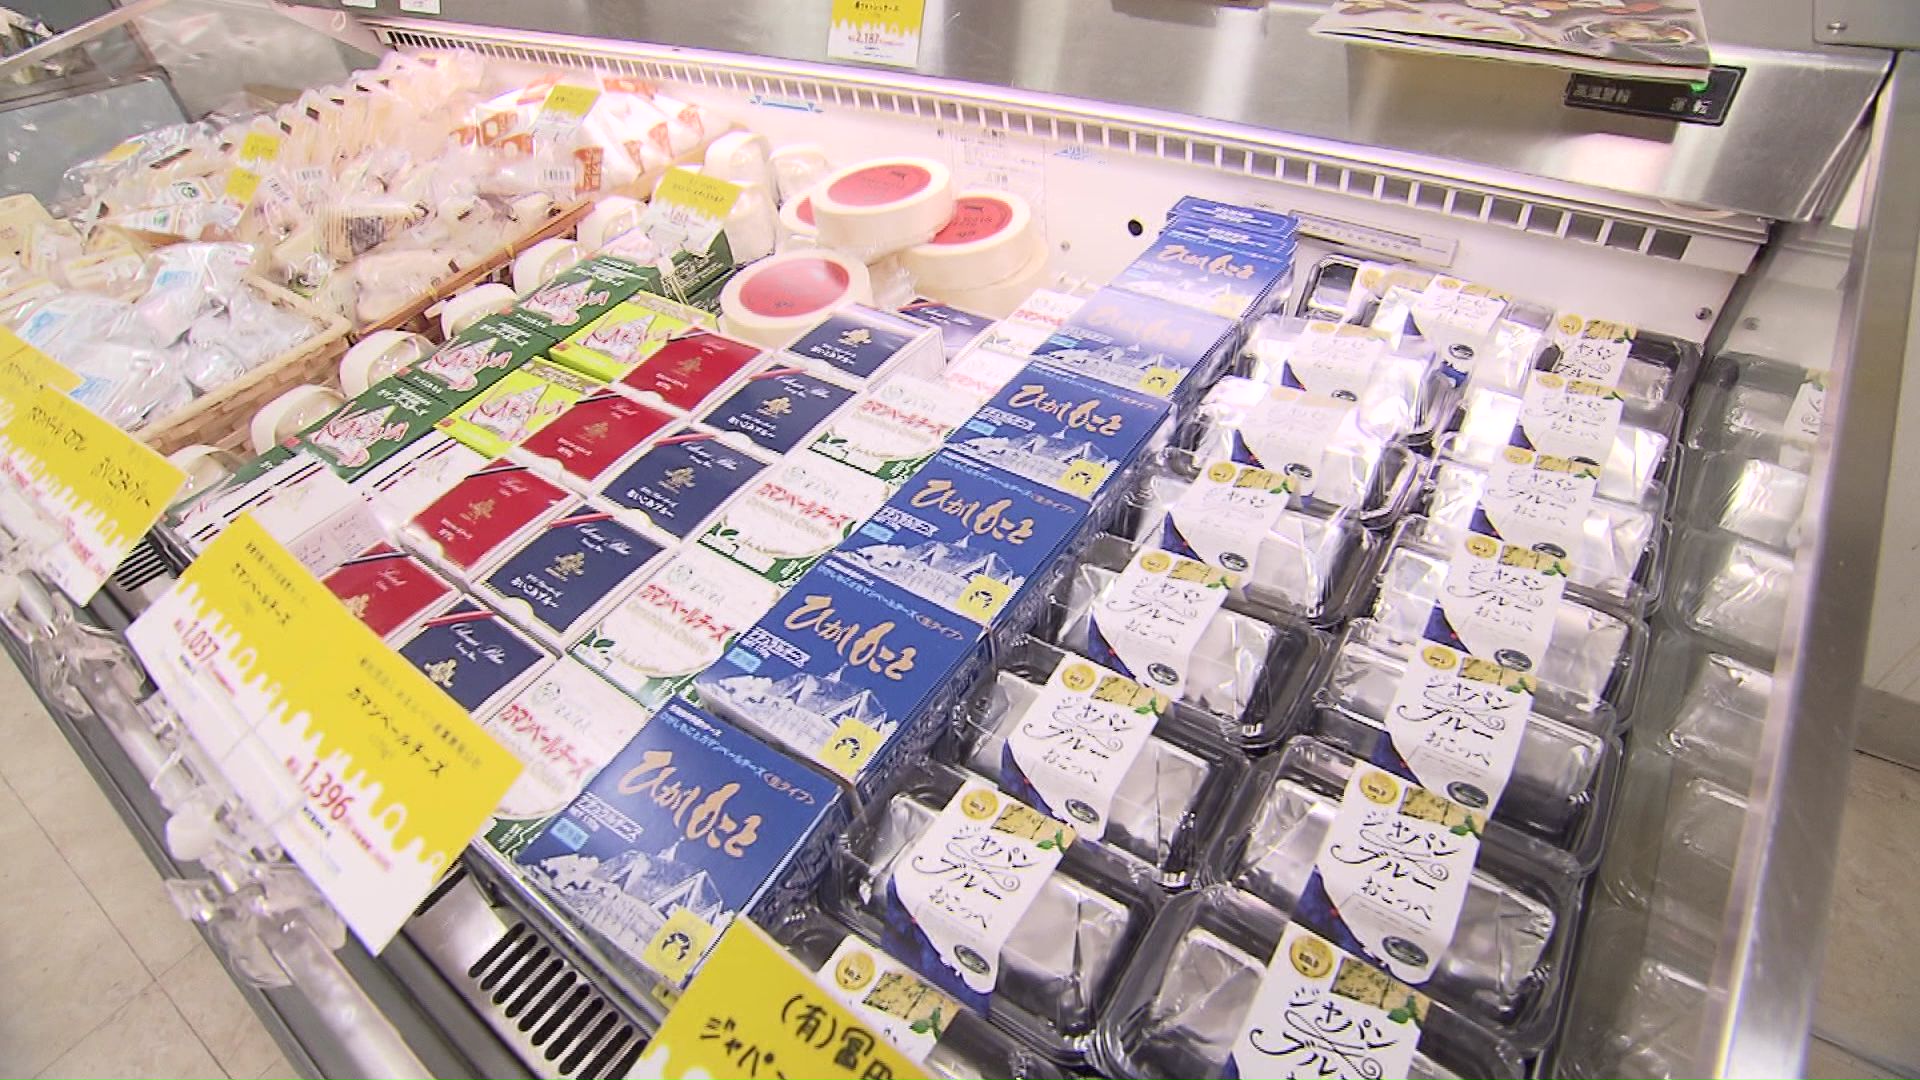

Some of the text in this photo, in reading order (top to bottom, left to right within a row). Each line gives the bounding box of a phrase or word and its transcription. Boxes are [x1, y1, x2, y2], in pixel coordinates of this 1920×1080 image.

[1008, 383, 1124, 437] ひがしもこと
[910, 478, 1036, 545] ひがしもこと
[638, 584, 734, 642] カマンベールチーズ
[784, 594, 917, 681] ひがしもこと
[1056, 696, 1134, 732] ジャパン
[1425, 674, 1512, 711] ジャパン
[349, 686, 447, 778] カマンベールチーズ
[500, 702, 598, 780] カマンベールチーズ
[1397, 704, 1495, 740] ブルー
[301, 760, 353, 820] 1,396
[617, 750, 763, 859] ひがしもこと
[951, 823, 1042, 869] ジャパン
[1362, 808, 1461, 857] ジャパン
[912, 854, 1003, 900] ブルー
[1330, 844, 1437, 890] ブルー
[1360, 875, 1433, 922] おこっぺ
[1288, 986, 1399, 1048] ジャパン
[699, 1016, 786, 1080] ジャパ
